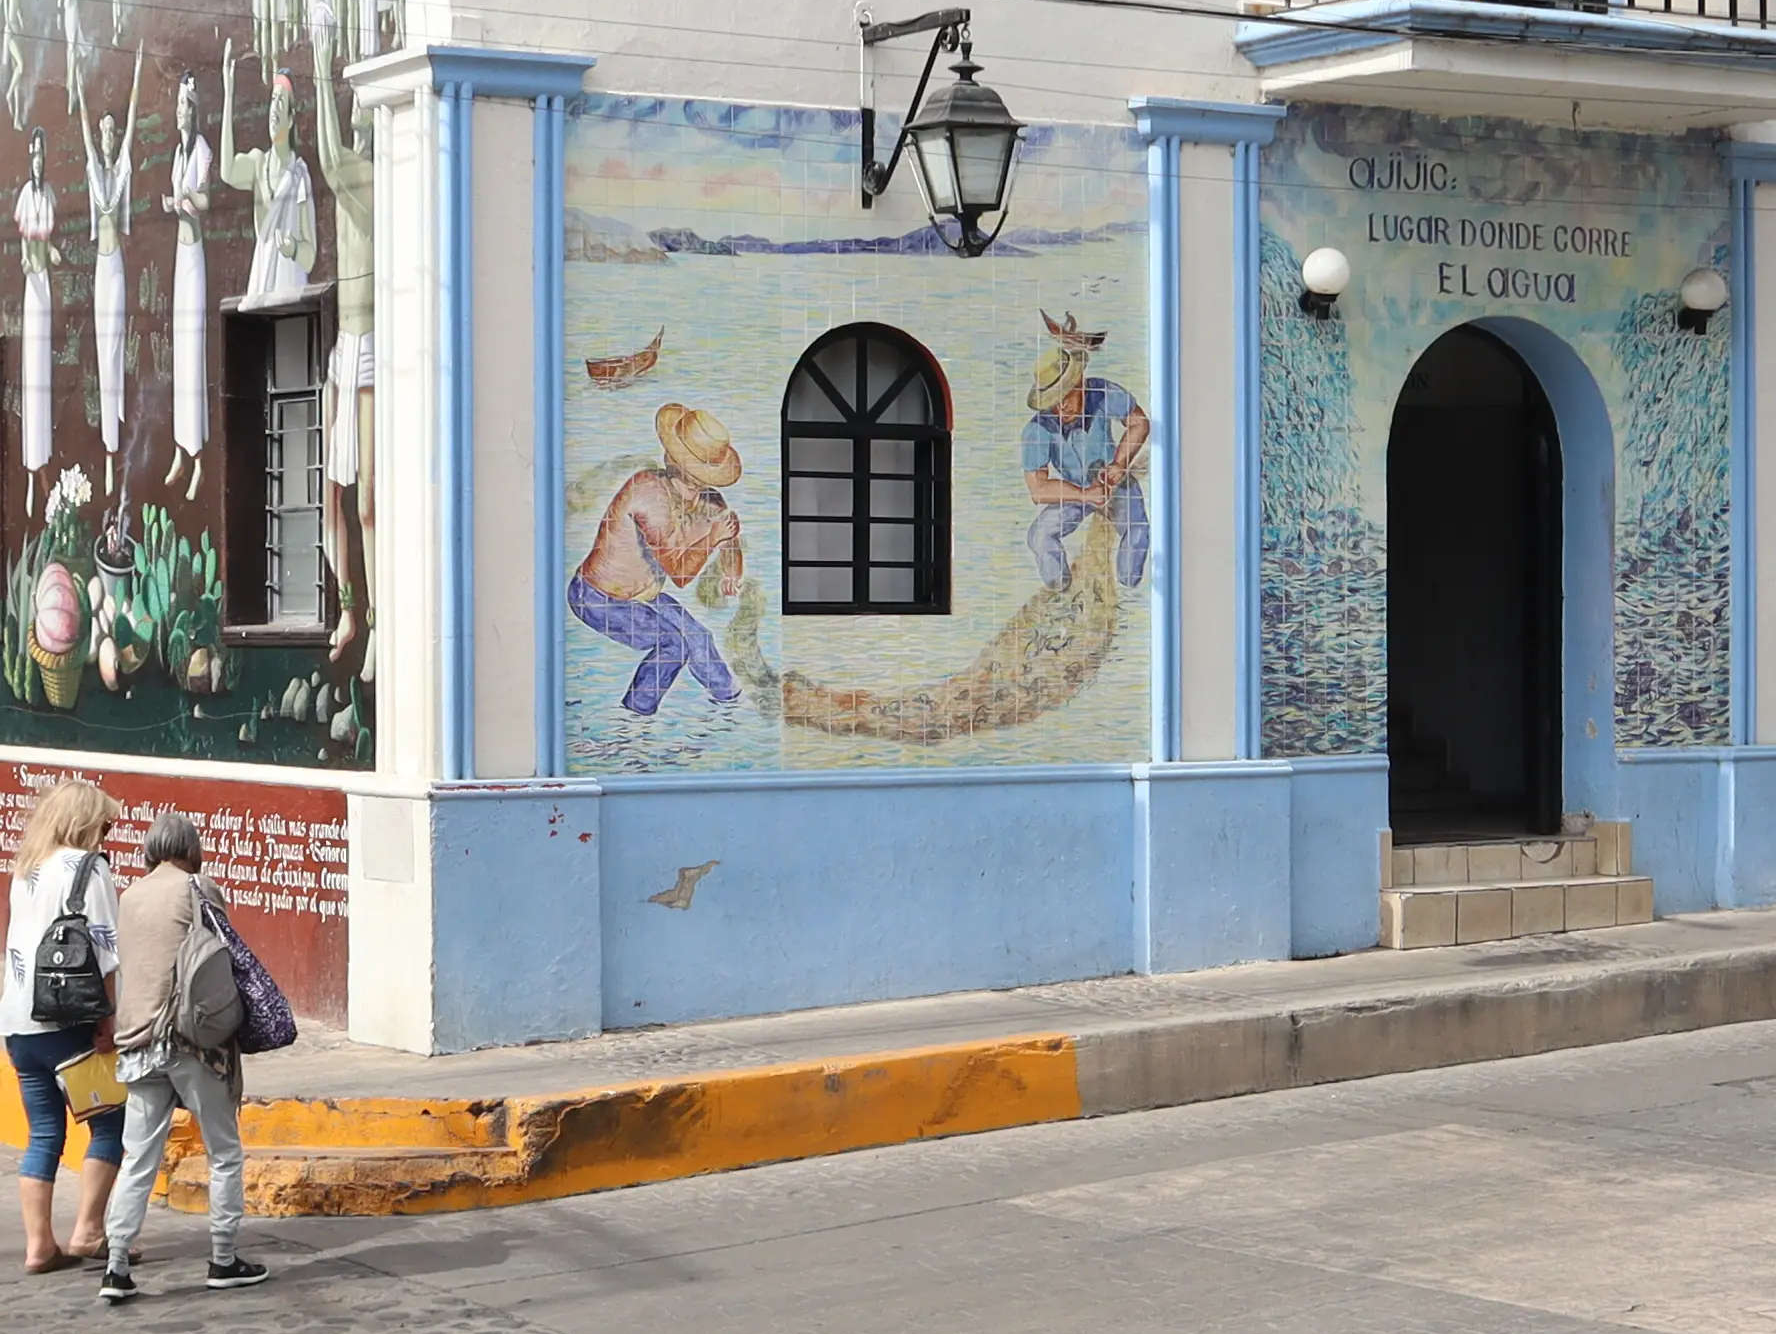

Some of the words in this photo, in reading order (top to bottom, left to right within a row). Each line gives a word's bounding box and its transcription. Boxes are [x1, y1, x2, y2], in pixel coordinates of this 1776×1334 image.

[1458, 218, 1546, 251] DONDE
[1553, 224, 1633, 258] CORRE
[1437, 261, 1478, 297] EL
